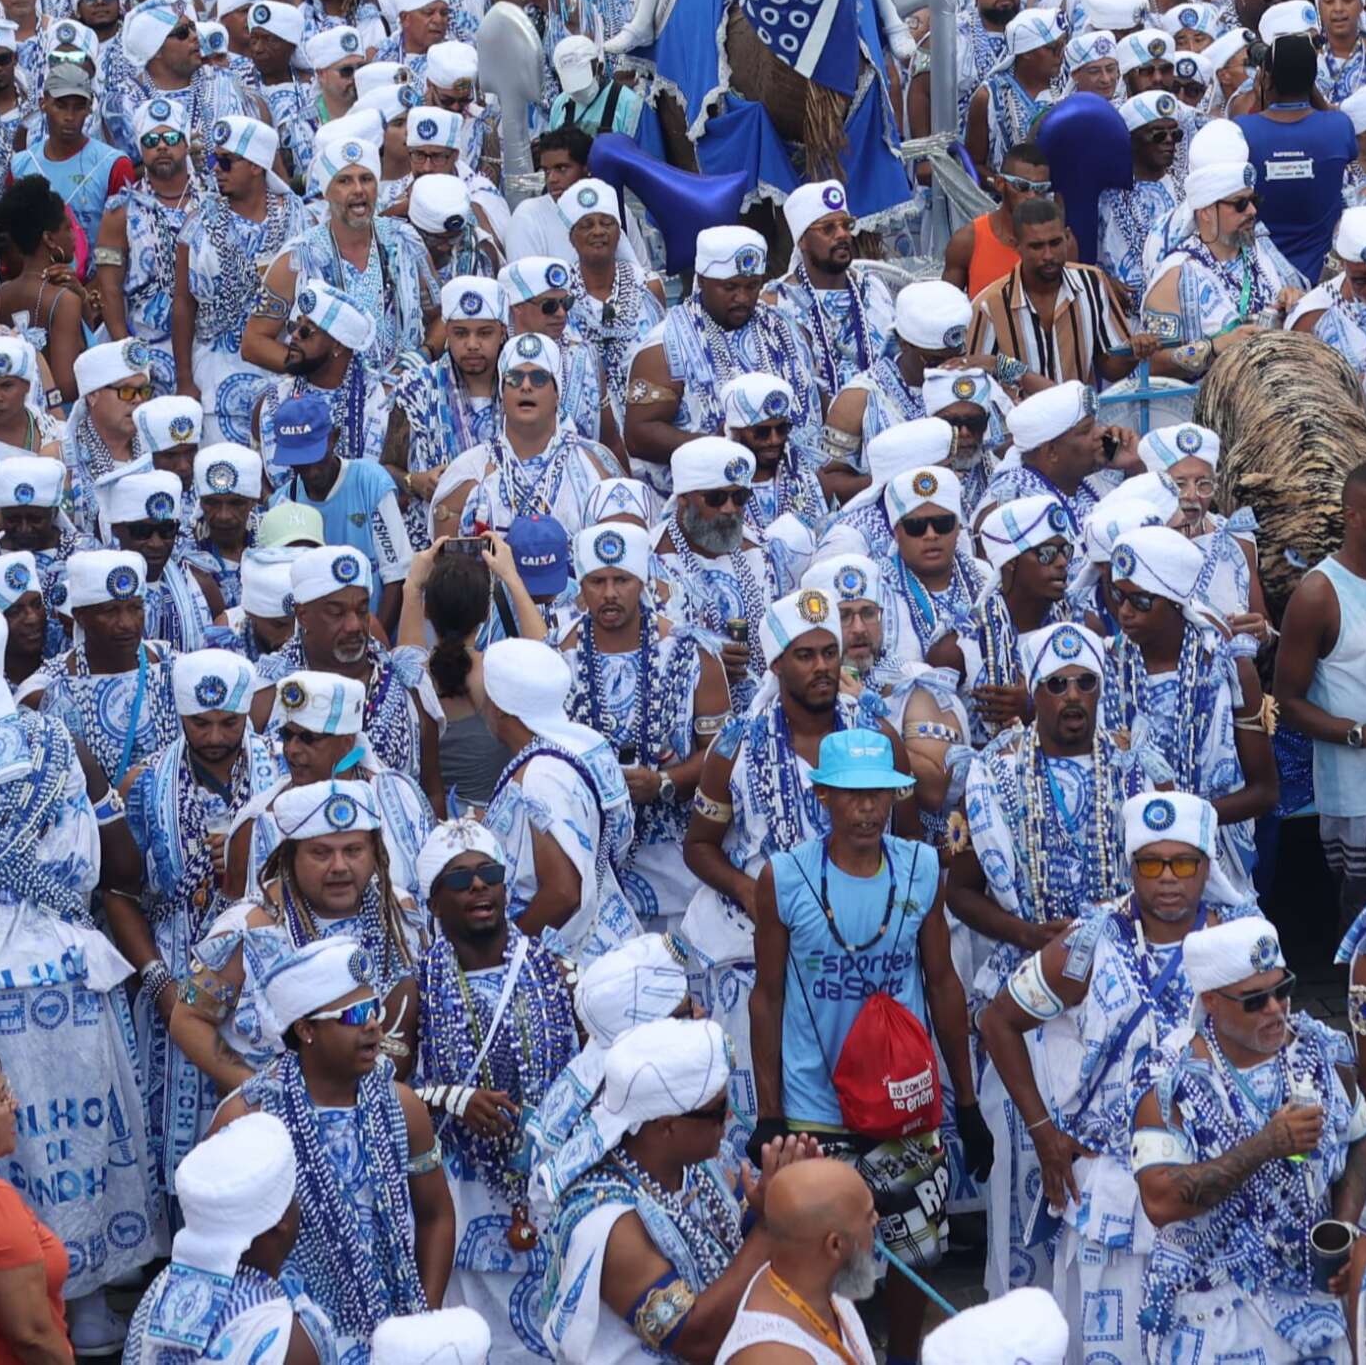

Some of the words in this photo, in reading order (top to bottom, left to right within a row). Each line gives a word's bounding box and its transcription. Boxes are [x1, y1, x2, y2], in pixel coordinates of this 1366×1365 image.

[280, 423, 312, 435] CAIXA
[521, 552, 556, 566] CAIXA
[805, 950, 914, 977] Esportes
[893, 1100, 905, 1111] no
